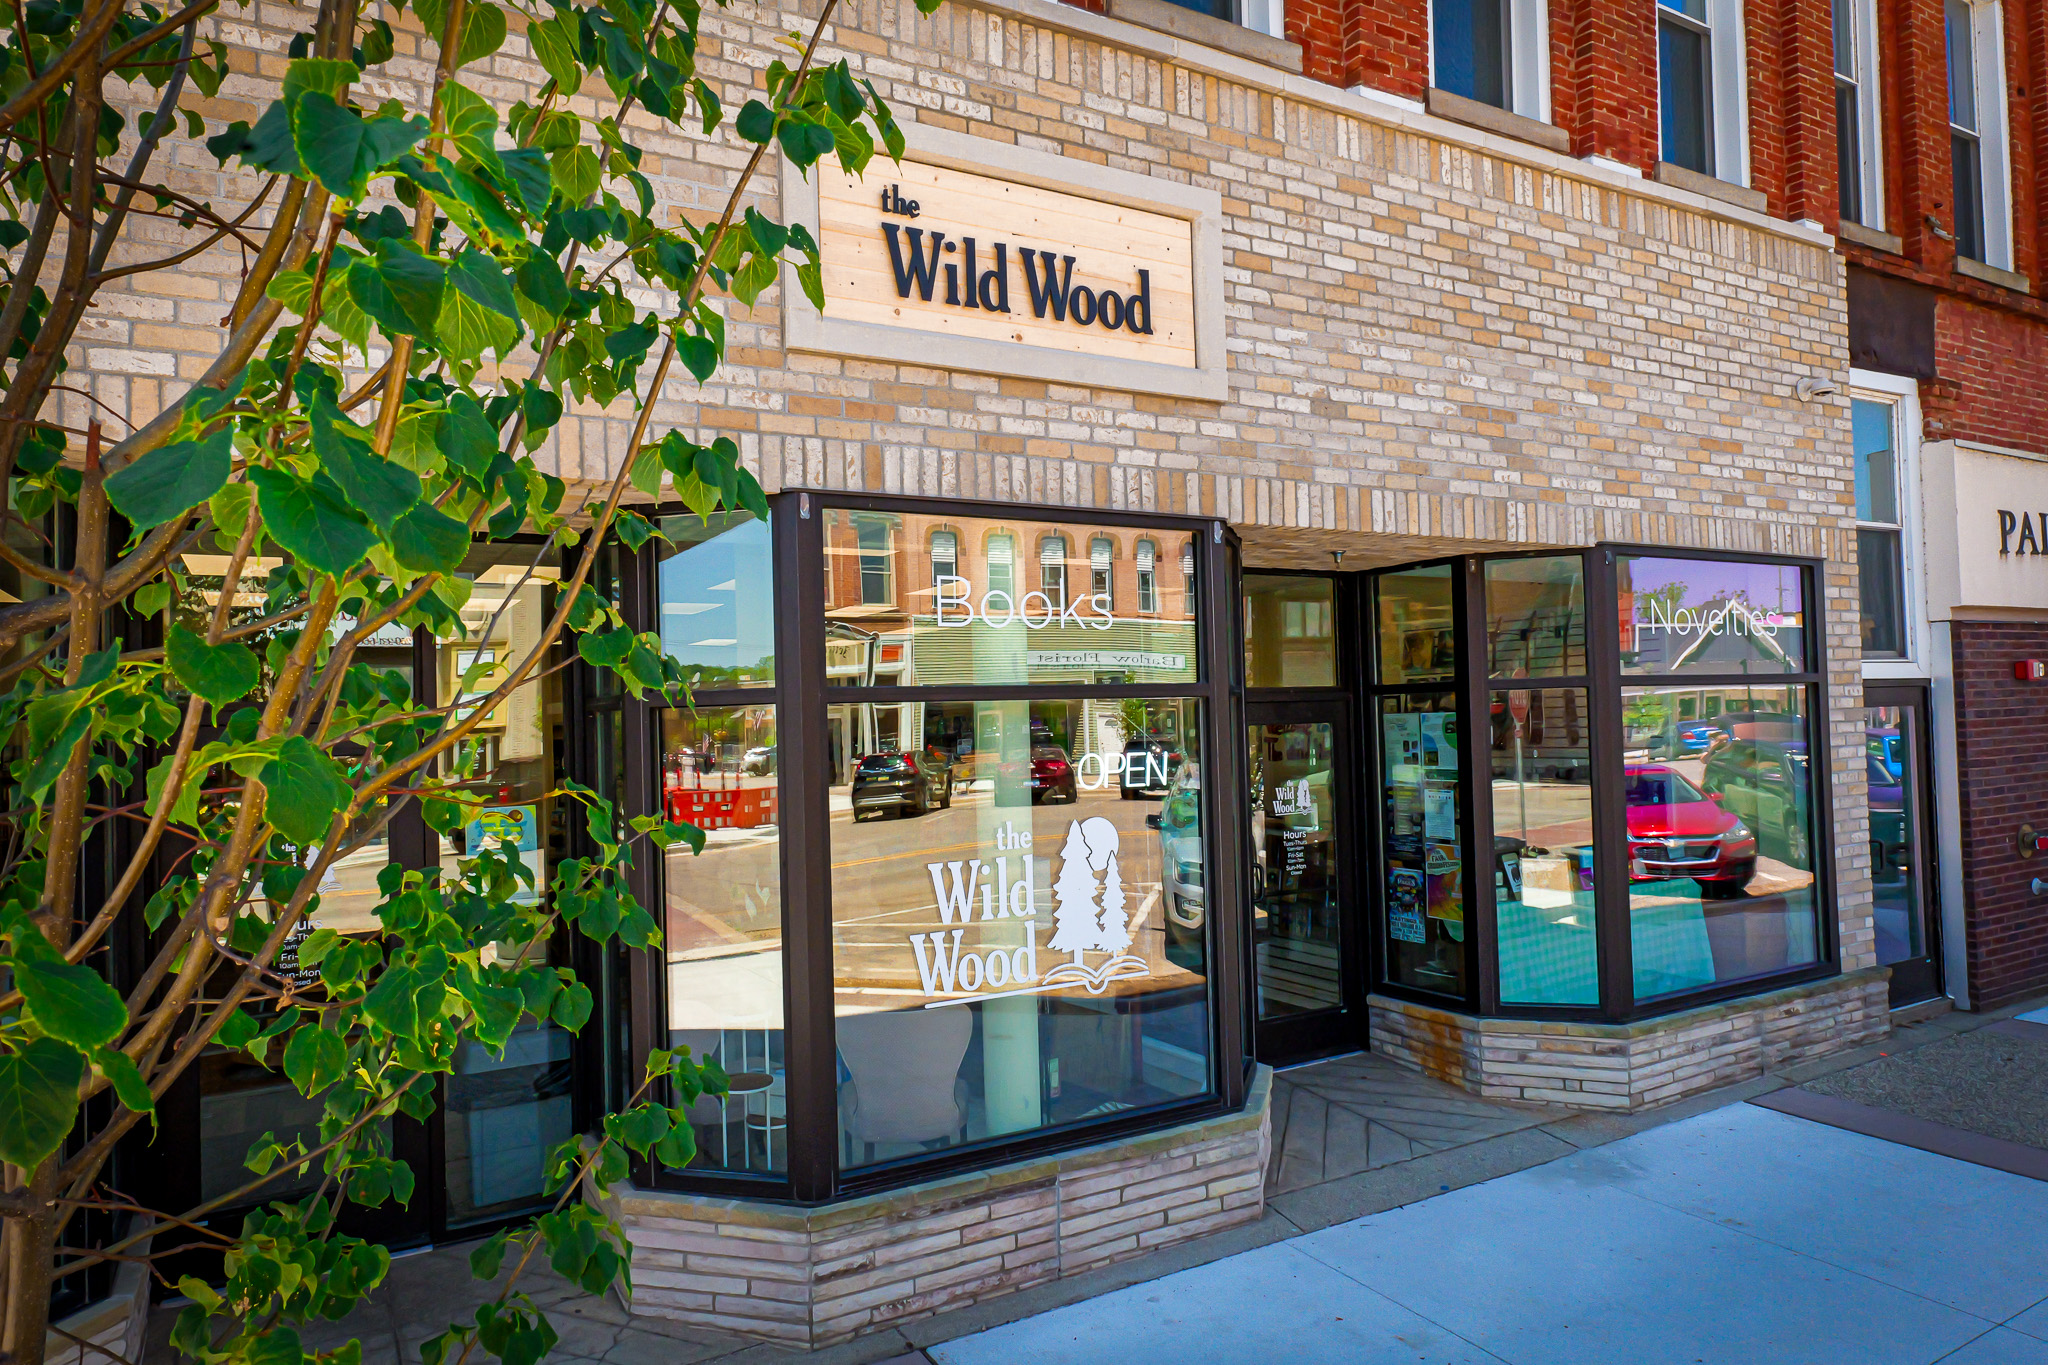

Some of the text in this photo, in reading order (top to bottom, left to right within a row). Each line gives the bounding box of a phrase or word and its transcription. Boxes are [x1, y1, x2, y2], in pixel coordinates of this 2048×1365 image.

[881, 185, 920, 218] the
[882, 222, 1153, 335] Wild Wood
[937, 575, 1113, 630] Books
[1650, 598, 1778, 636] Novelties
[1078, 751, 1168, 790] OPEN
[1273, 800, 1295, 814] Wood
[1275, 787, 1294, 800] Wild
[997, 820, 1032, 850] the
[1283, 831, 1307, 840] Hours
[1285, 864, 1307, 872] Sun-Mon
[928, 854, 1036, 925] Wild
[910, 920, 1038, 997] Wood
